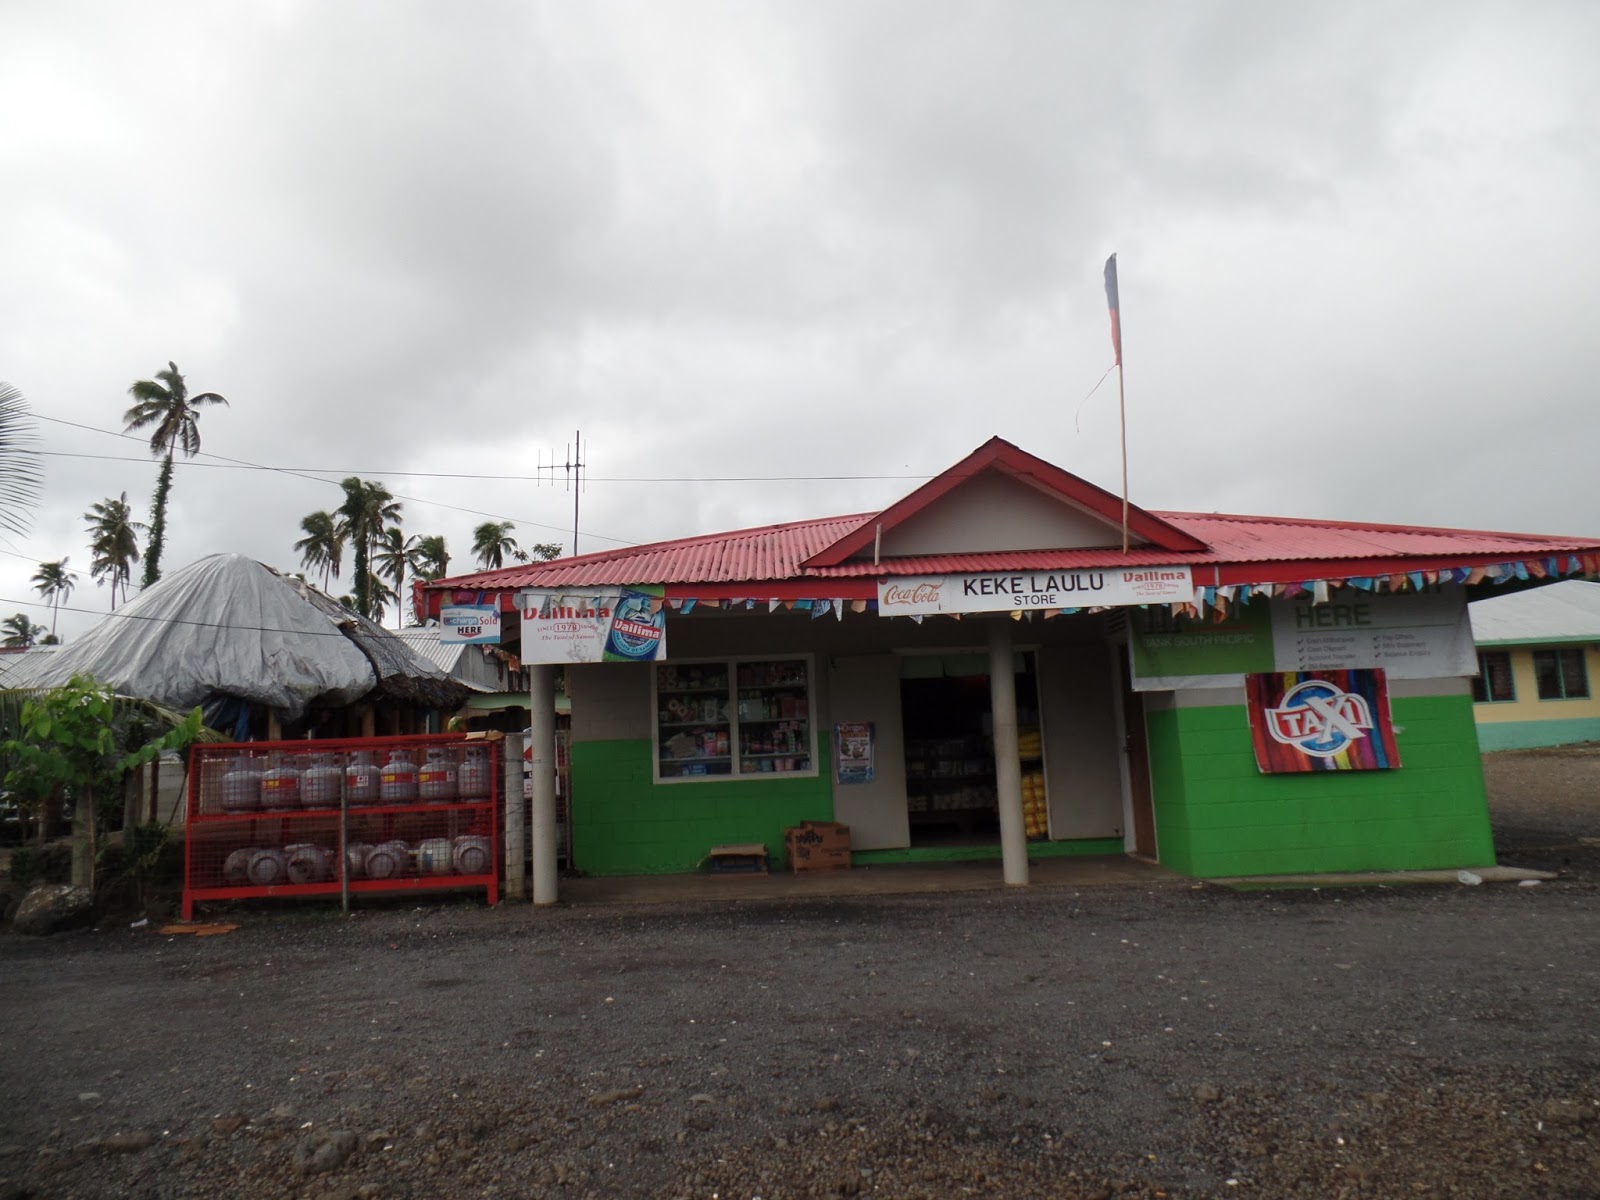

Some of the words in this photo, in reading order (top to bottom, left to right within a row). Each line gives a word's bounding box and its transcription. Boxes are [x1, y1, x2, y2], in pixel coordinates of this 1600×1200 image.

[1123, 571, 1185, 582] Vailima
[964, 577, 1023, 596] KEKE
[1031, 574, 1104, 593] LAULU
[883, 582, 944, 605] Coca-Cola
[1013, 594, 1057, 606] STORE
[479, 616, 499, 625] Sold
[1296, 603, 1371, 628] HERE
[458, 626, 482, 634] HERE
[614, 619, 660, 639] Vailima
[1174, 635, 1213, 647] SOUTH
[1281, 696, 1366, 744] TAXI
